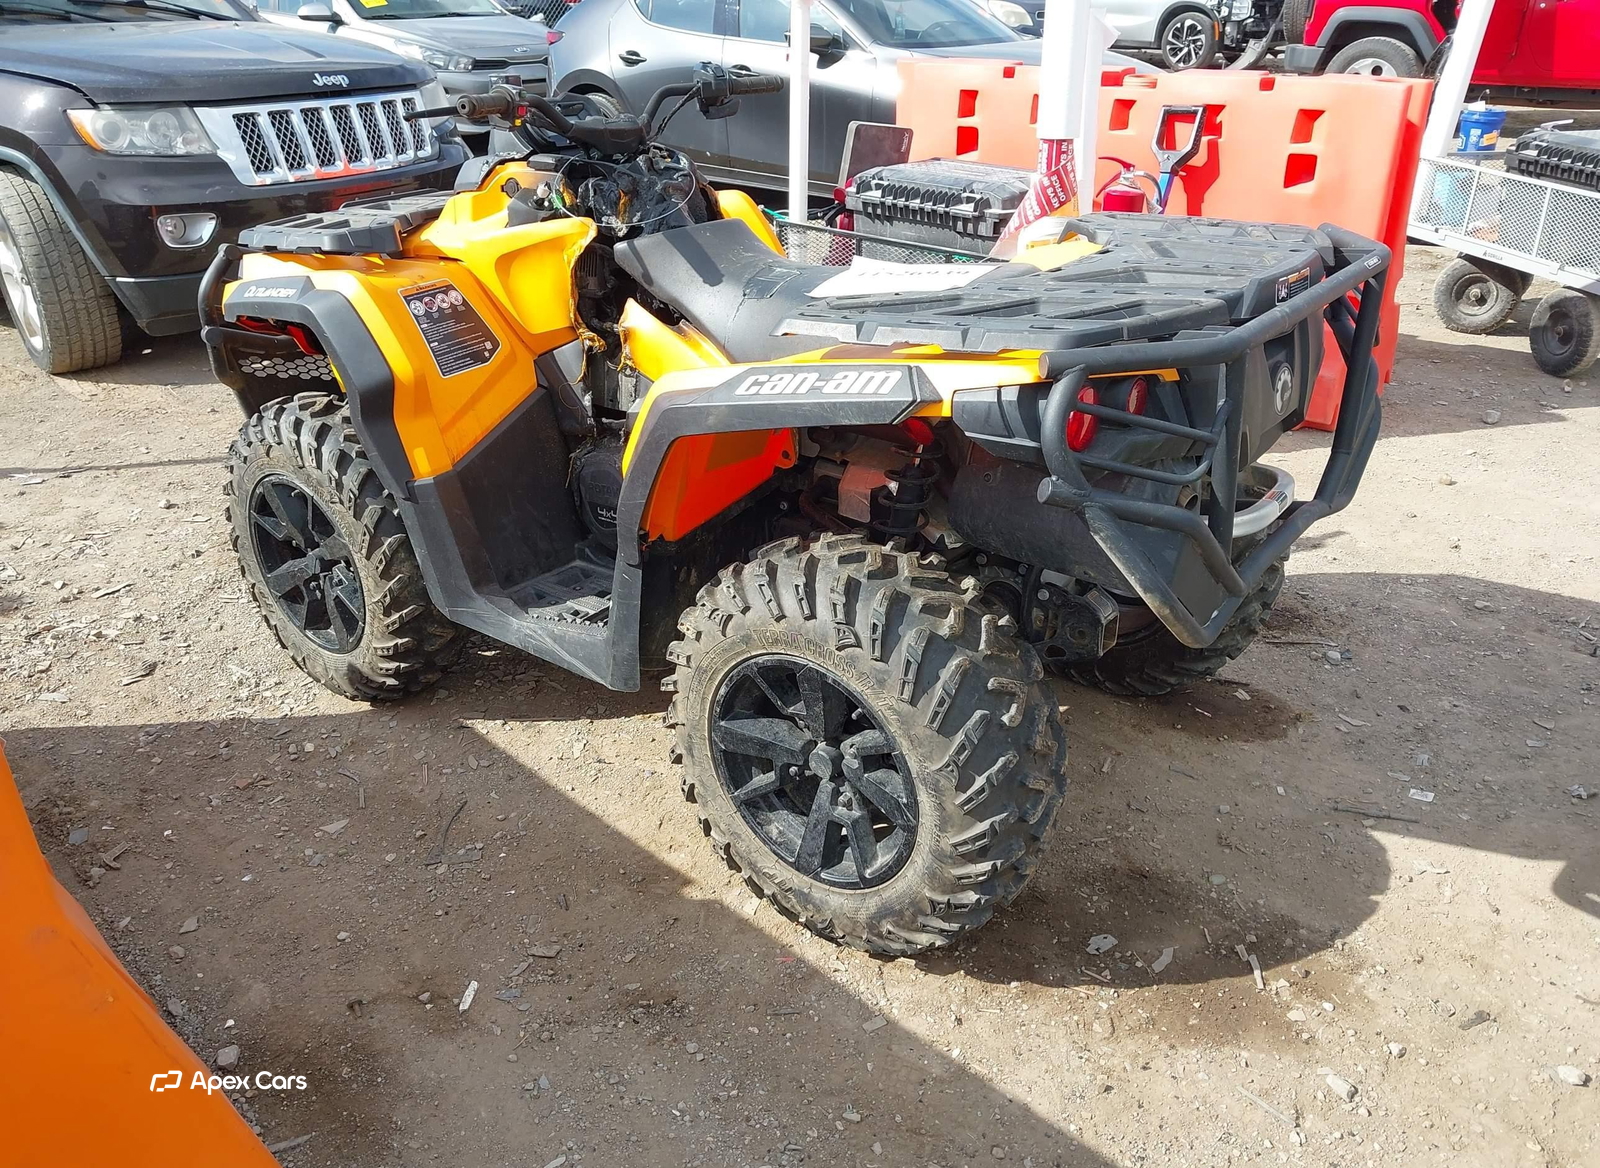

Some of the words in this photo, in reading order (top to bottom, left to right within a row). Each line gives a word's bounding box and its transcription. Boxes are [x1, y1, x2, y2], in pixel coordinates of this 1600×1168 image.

[312, 72, 350, 88] Jeep
[1041, 175, 1050, 187] IN
[1051, 174, 1066, 202] OFFICE
[1046, 187, 1060, 208] KEYS
[733, 370, 903, 396] can-am
